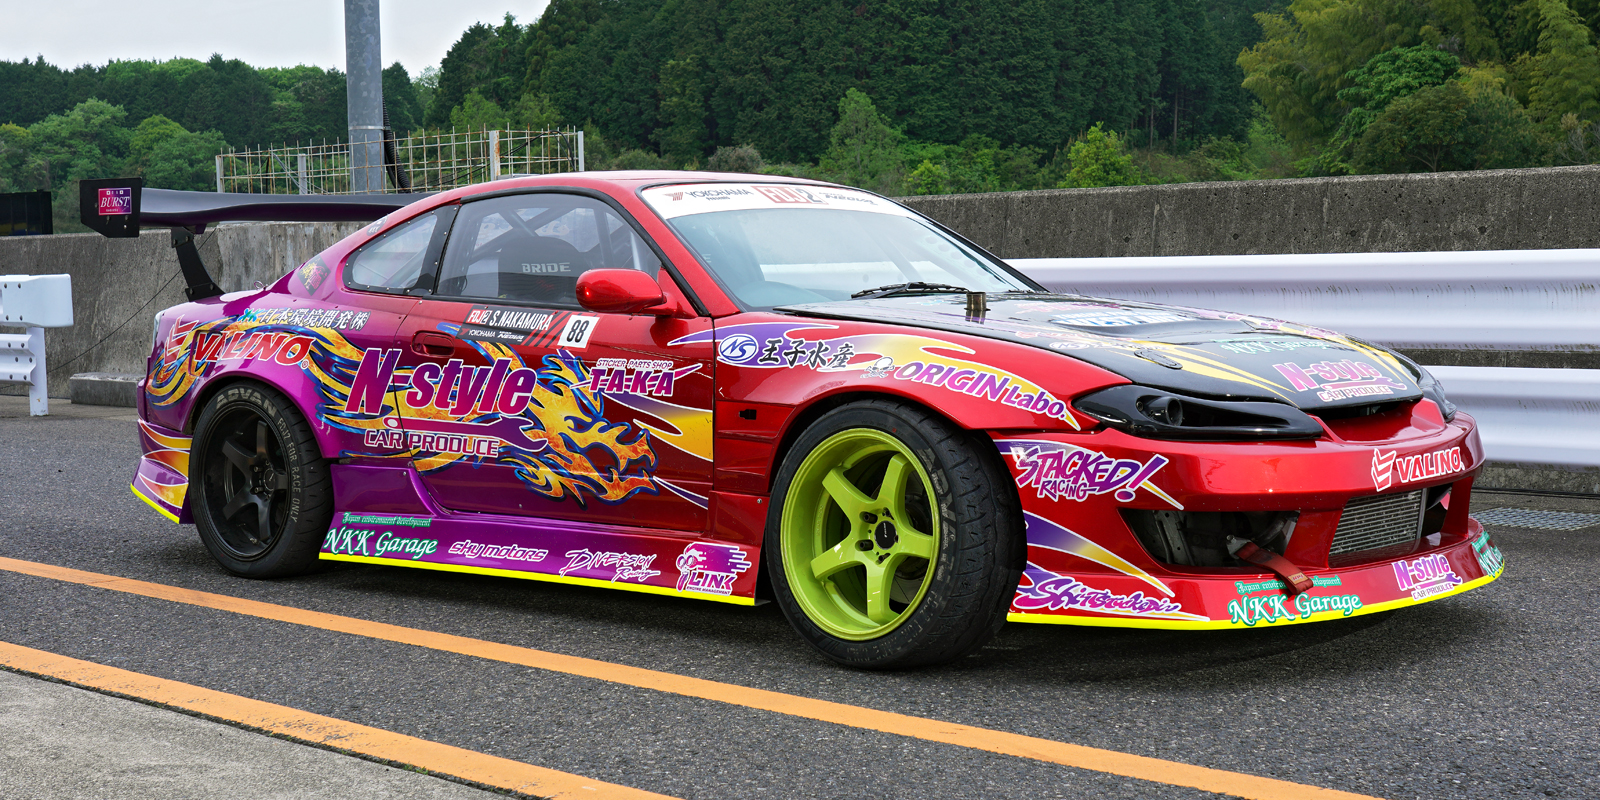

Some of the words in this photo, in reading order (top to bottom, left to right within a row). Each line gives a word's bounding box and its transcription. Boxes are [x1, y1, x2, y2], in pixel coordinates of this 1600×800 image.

[101, 196, 130, 208] BURST
[521, 262, 571, 273] BRIDE
[468, 329, 496, 338] YOKOHAMA
[489, 310, 553, 331] S.NAKAMURA
[566, 319, 590, 343] 88
[596, 358, 626, 368] STICKER
[627, 360, 651, 369] PARTS
[652, 361, 674, 370] SHOP
[758, 338, 854, 369] 王子水産
[344, 348, 537, 416] N-style
[894, 361, 1012, 401] ORIGIN
[1272, 359, 1382, 392] N-style
[216, 387, 277, 417] ADVAN
[1317, 388, 1345, 402] CAR
[1345, 385, 1394, 400] PRODUCE
[365, 429, 403, 448] CAR
[408, 432, 499, 458] PRODUCE
[291, 466, 301, 493] RACE
[1015, 445, 1169, 502] STACKED!
[1037, 479, 1098, 502] RACING
[290, 497, 301, 523] ONLY
[323, 526, 375, 556] NKK
[374, 530, 439, 560] Garage
[448, 540, 484, 559] sky
[482, 544, 548, 562] motors
[559, 548, 657, 578] DIVERSION
[1392, 553, 1450, 591] N-style
[688, 570, 737, 591] LINK
[702, 587, 731, 595] MANAGEMENT
[1411, 589, 1427, 601] CAR
[1426, 582, 1454, 598] PRODUCE
[1227, 593, 1296, 627] NKK
[1294, 592, 1363, 619] Garage
